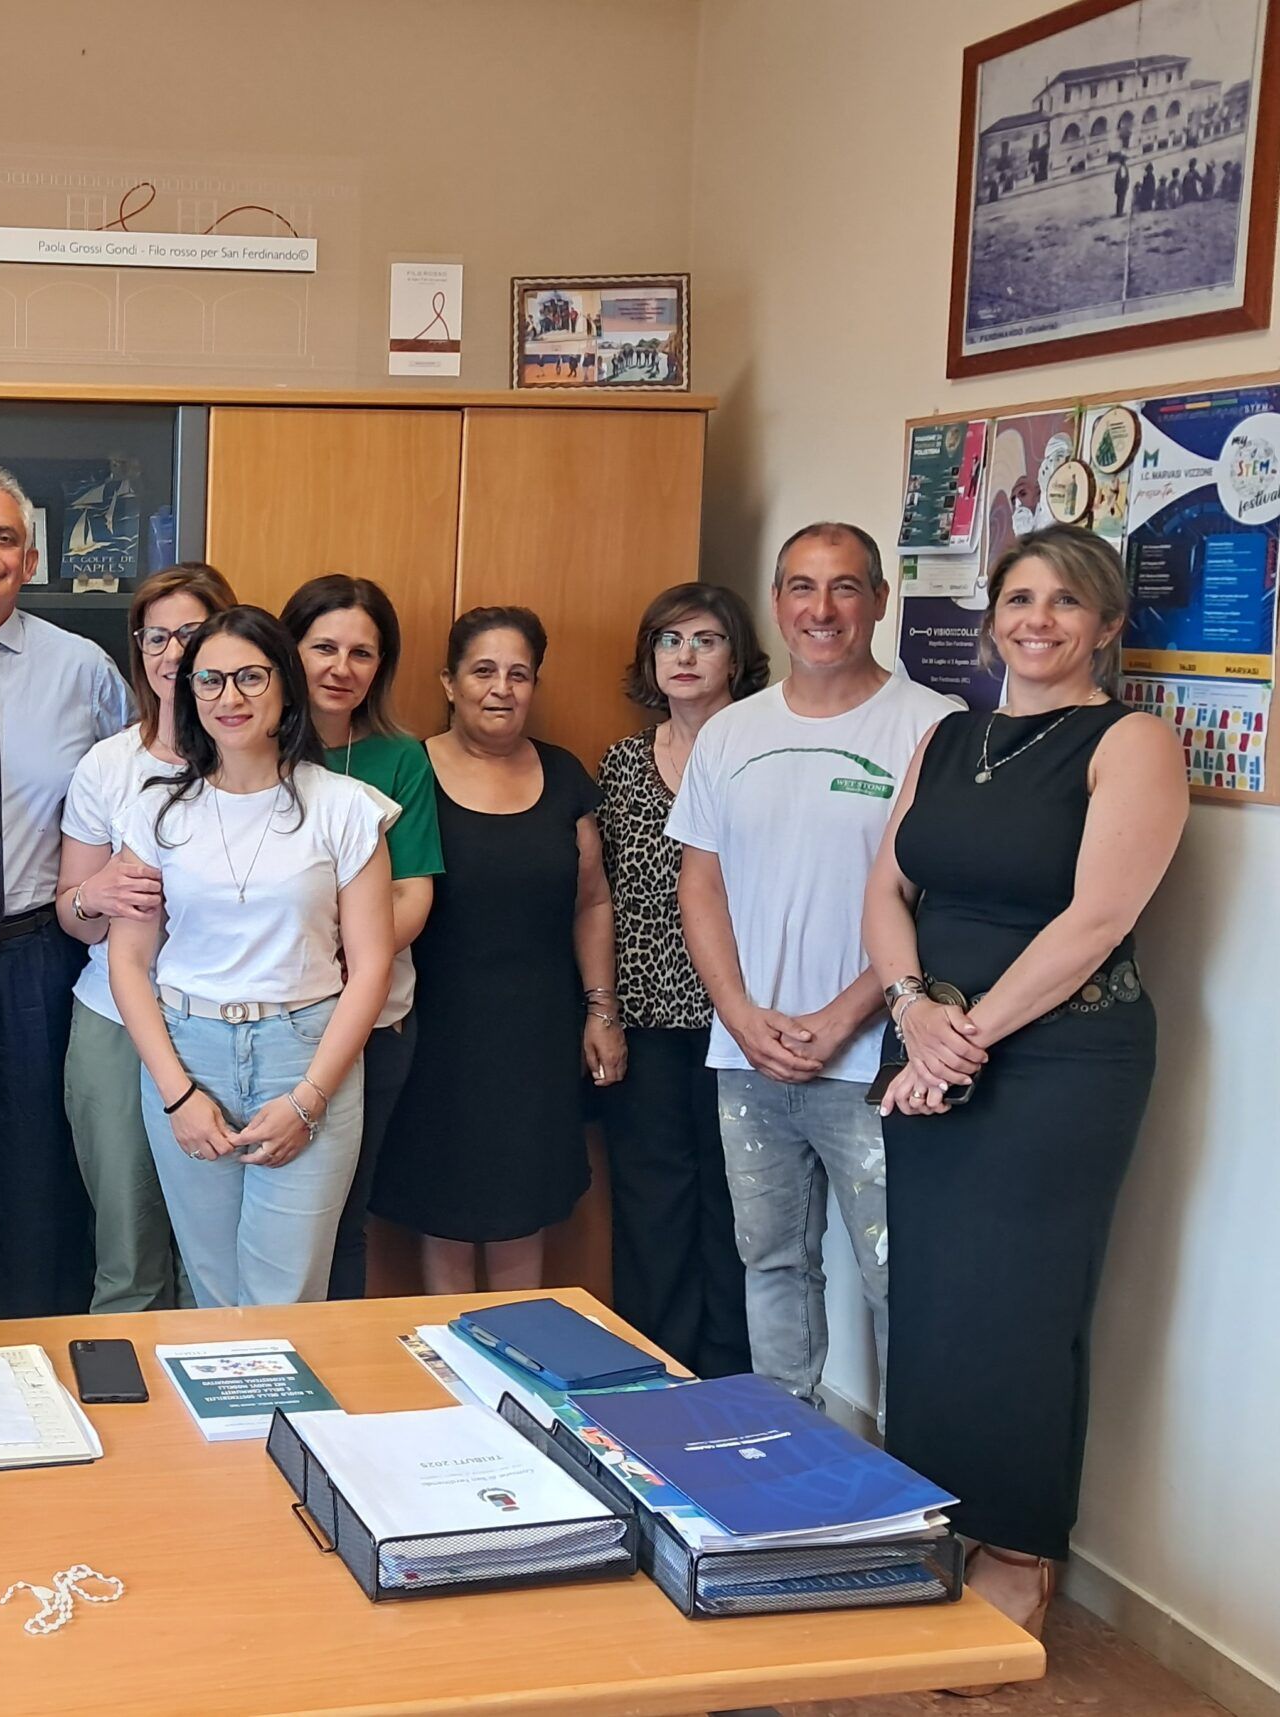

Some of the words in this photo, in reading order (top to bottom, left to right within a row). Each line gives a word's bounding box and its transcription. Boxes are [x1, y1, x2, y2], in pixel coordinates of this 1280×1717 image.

[38, 240, 66, 254] Paola
[69, 242, 102, 255] Grossi
[105, 243, 137, 256] Gondi
[148, 244, 166, 257] Filo
[169, 248, 196, 258] rosso
[201, 249, 218, 260] per
[221, 247, 239, 258] San
[1231, 435, 1248, 449] my
[1237, 459, 1270, 477] STEM
[1152, 469, 1182, 480] MARVASI
[120, 555, 136, 563] DE
[72, 563, 125, 573] NAPLES
[1225, 666, 1259, 676] MARVASI
[836, 779, 855, 787] WET
[857, 780, 888, 792] STONE
[419, 1460, 449, 1469] 2025
[453, 1454, 504, 1466] TRIBUTI
